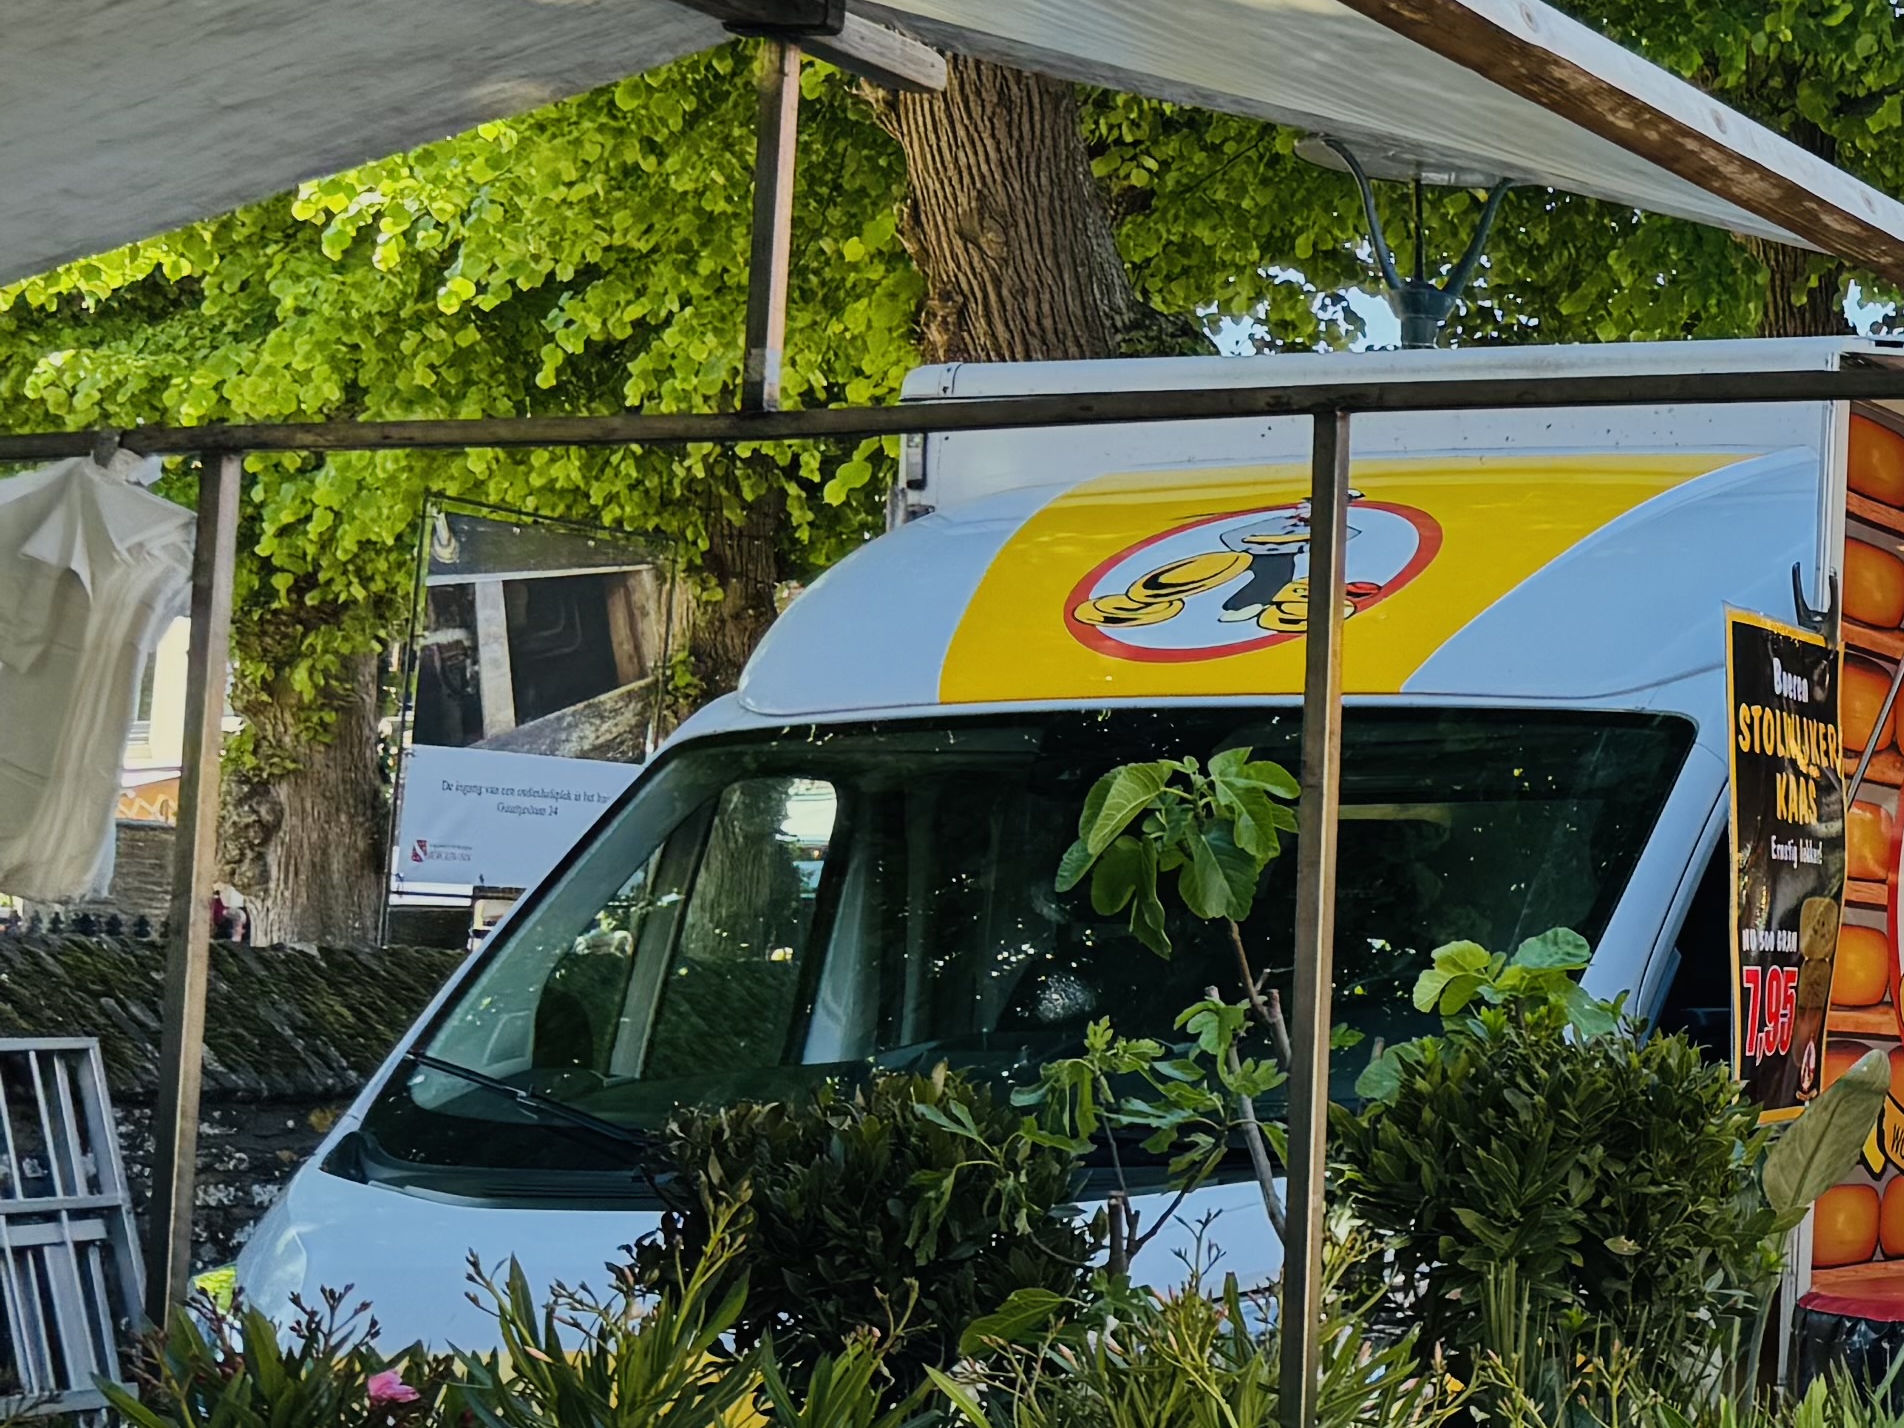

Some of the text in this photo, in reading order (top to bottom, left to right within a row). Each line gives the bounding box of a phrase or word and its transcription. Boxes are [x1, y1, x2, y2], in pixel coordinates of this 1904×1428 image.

[1772, 657, 1809, 703] Boeren
[1738, 702, 1842, 770] STOLWIJKER
[1775, 771, 1818, 826] KAAS
[1741, 928, 1757, 952] NU
[1759, 930, 1776, 952] 500
[1742, 965, 1799, 1067] 7,95
